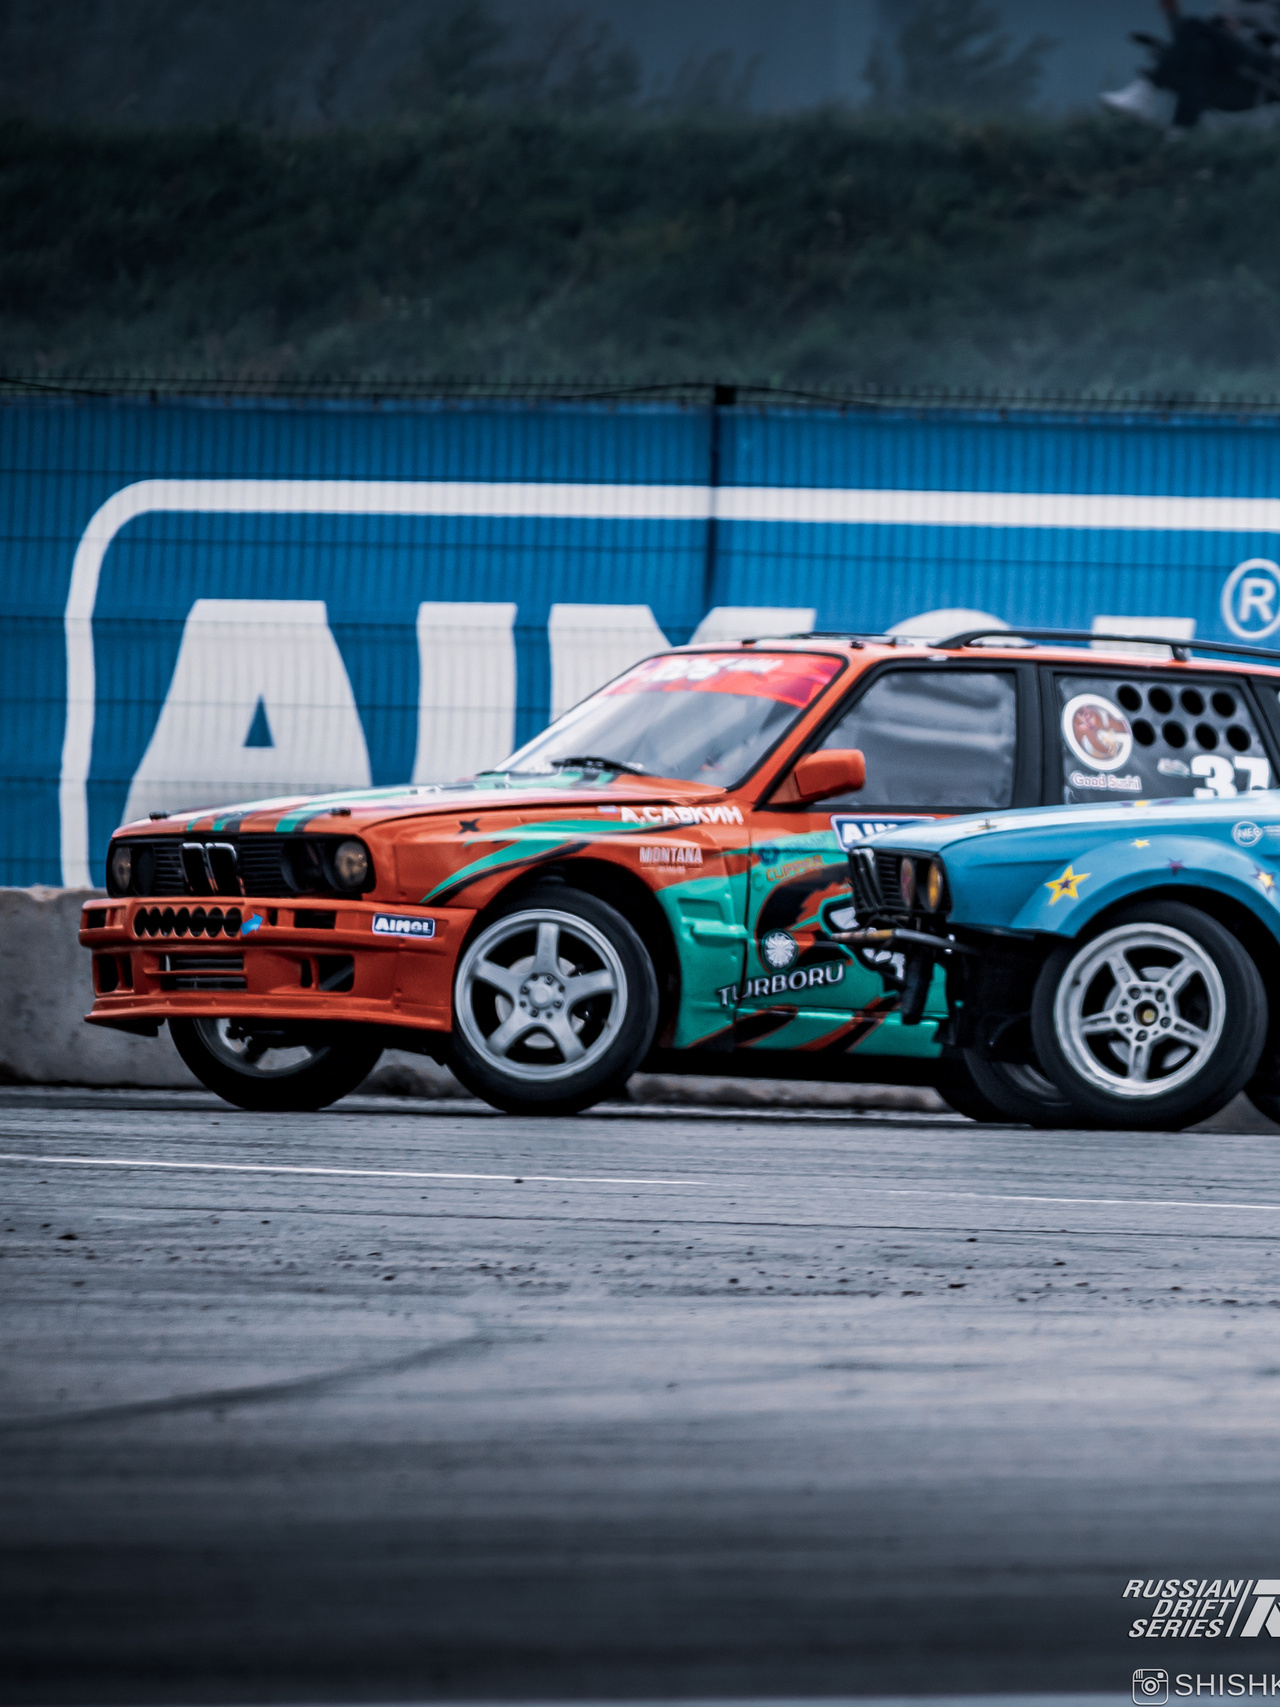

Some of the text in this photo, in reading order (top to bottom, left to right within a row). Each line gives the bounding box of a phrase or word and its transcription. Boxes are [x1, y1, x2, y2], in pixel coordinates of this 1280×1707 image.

[1190, 754, 1271, 800] 37
[639, 846, 704, 864] MONTANA
[375, 917, 431, 934] AIMOL
[718, 963, 845, 1007] TURBORU
